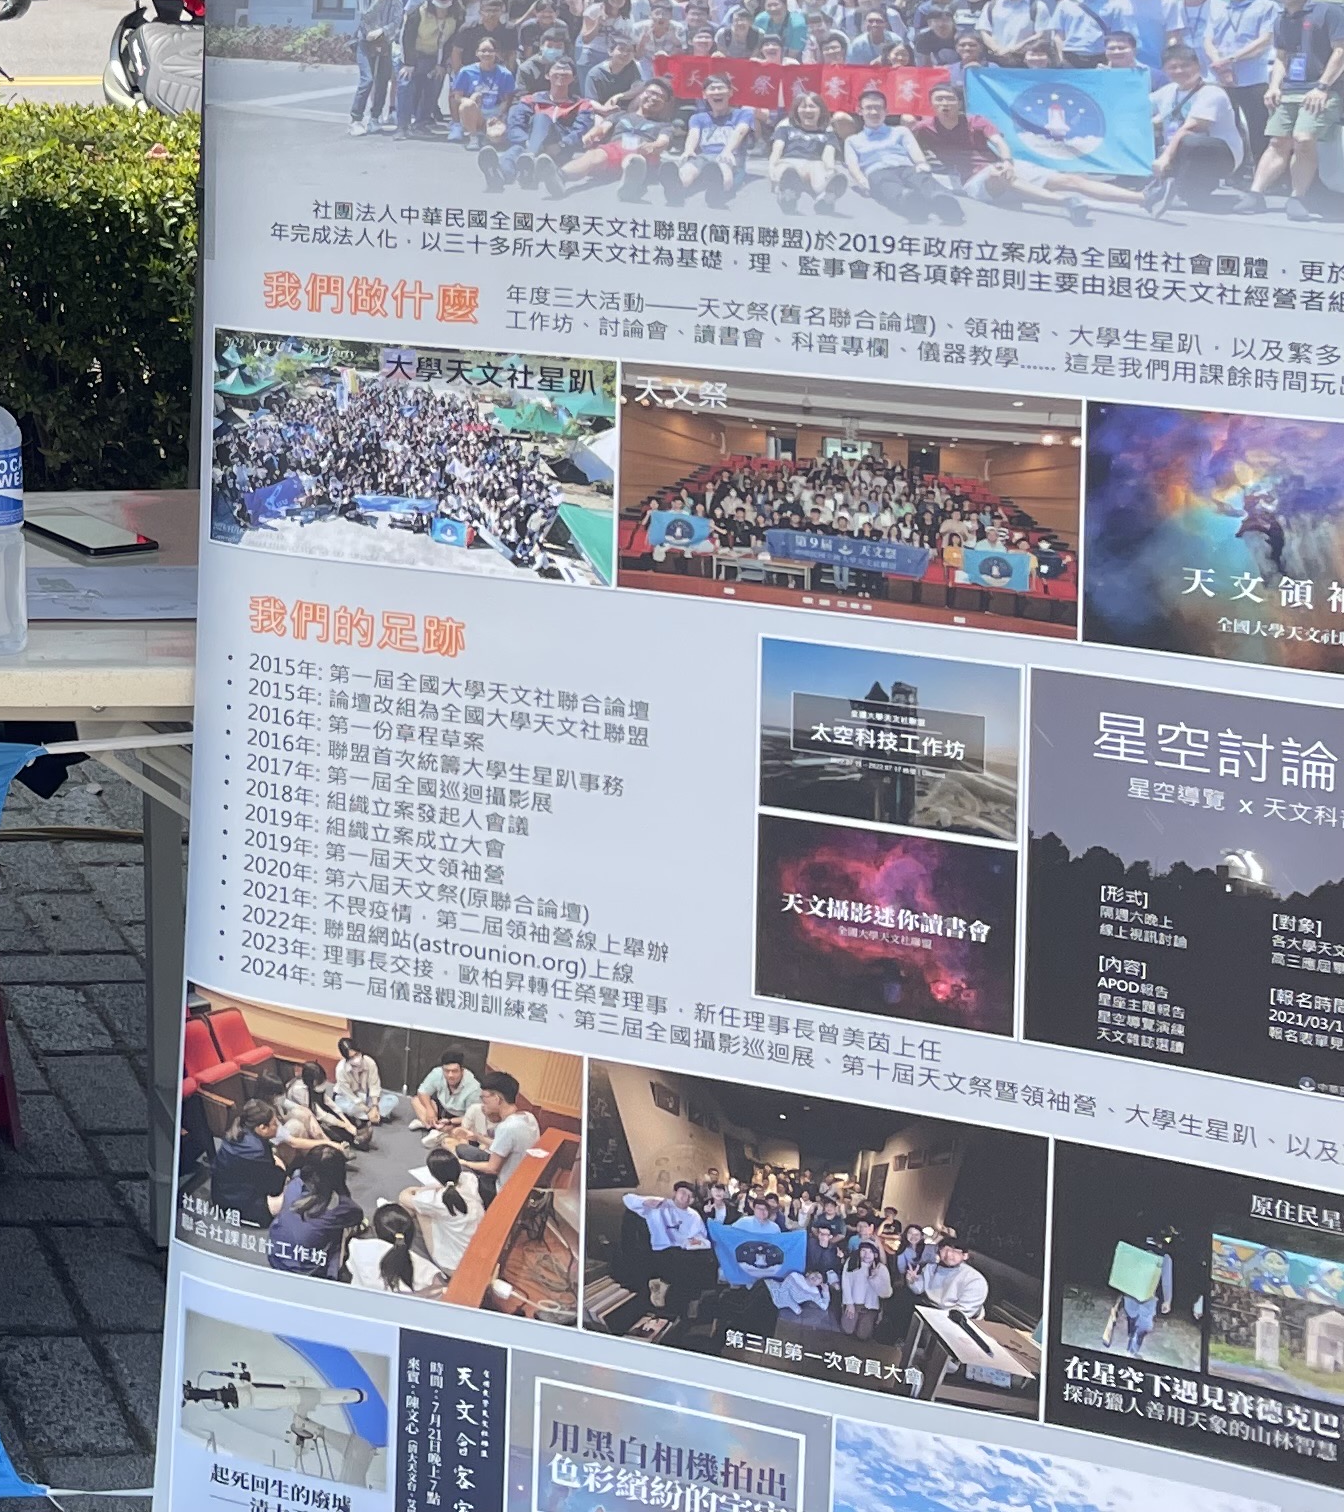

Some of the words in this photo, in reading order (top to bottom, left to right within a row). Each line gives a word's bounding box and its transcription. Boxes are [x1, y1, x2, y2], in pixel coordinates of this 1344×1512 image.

[263, 270, 481, 325] 我們做什麼
[385, 353, 598, 398] 大學天文社星趴
[634, 375, 729, 410] 天文祭
[248, 594, 467, 659] 我們的足跡
[328, 662, 651, 723] 第一屆全國大學天文社聯合論壇
[327, 712, 486, 753] 第一份章程草案
[328, 688, 651, 749] 論壇改組為全國大學天文社聯盟
[810, 722, 967, 761] 太空科技工作坊
[1093, 711, 1339, 793] 星空討論
[1127, 777, 1226, 812] 星空導覽
[1263, 796, 1344, 829] 天文科
[326, 816, 507, 858] 組織立案成立大會
[325, 840, 506, 885] 第一屆天文領袖營
[780, 891, 992, 945] 天文攝影迷你讀書會
[1100, 884, 1149, 910] [形式]
[1271, 912, 1323, 938] [對象]
[1097, 975, 1169, 1001] APOD報告
[1098, 954, 1147, 980] [內容]
[1250, 1193, 1344, 1230] 原住民星
[180, 1215, 328, 1269] 聯合社課設計工作坊
[725, 1327, 925, 1389] 第三屆第一次會員大會
[1062, 1382, 1339, 1462] 探訪獵人善用天象的山林智慧
[549, 1419, 788, 1502] 用黑白相機拍出
